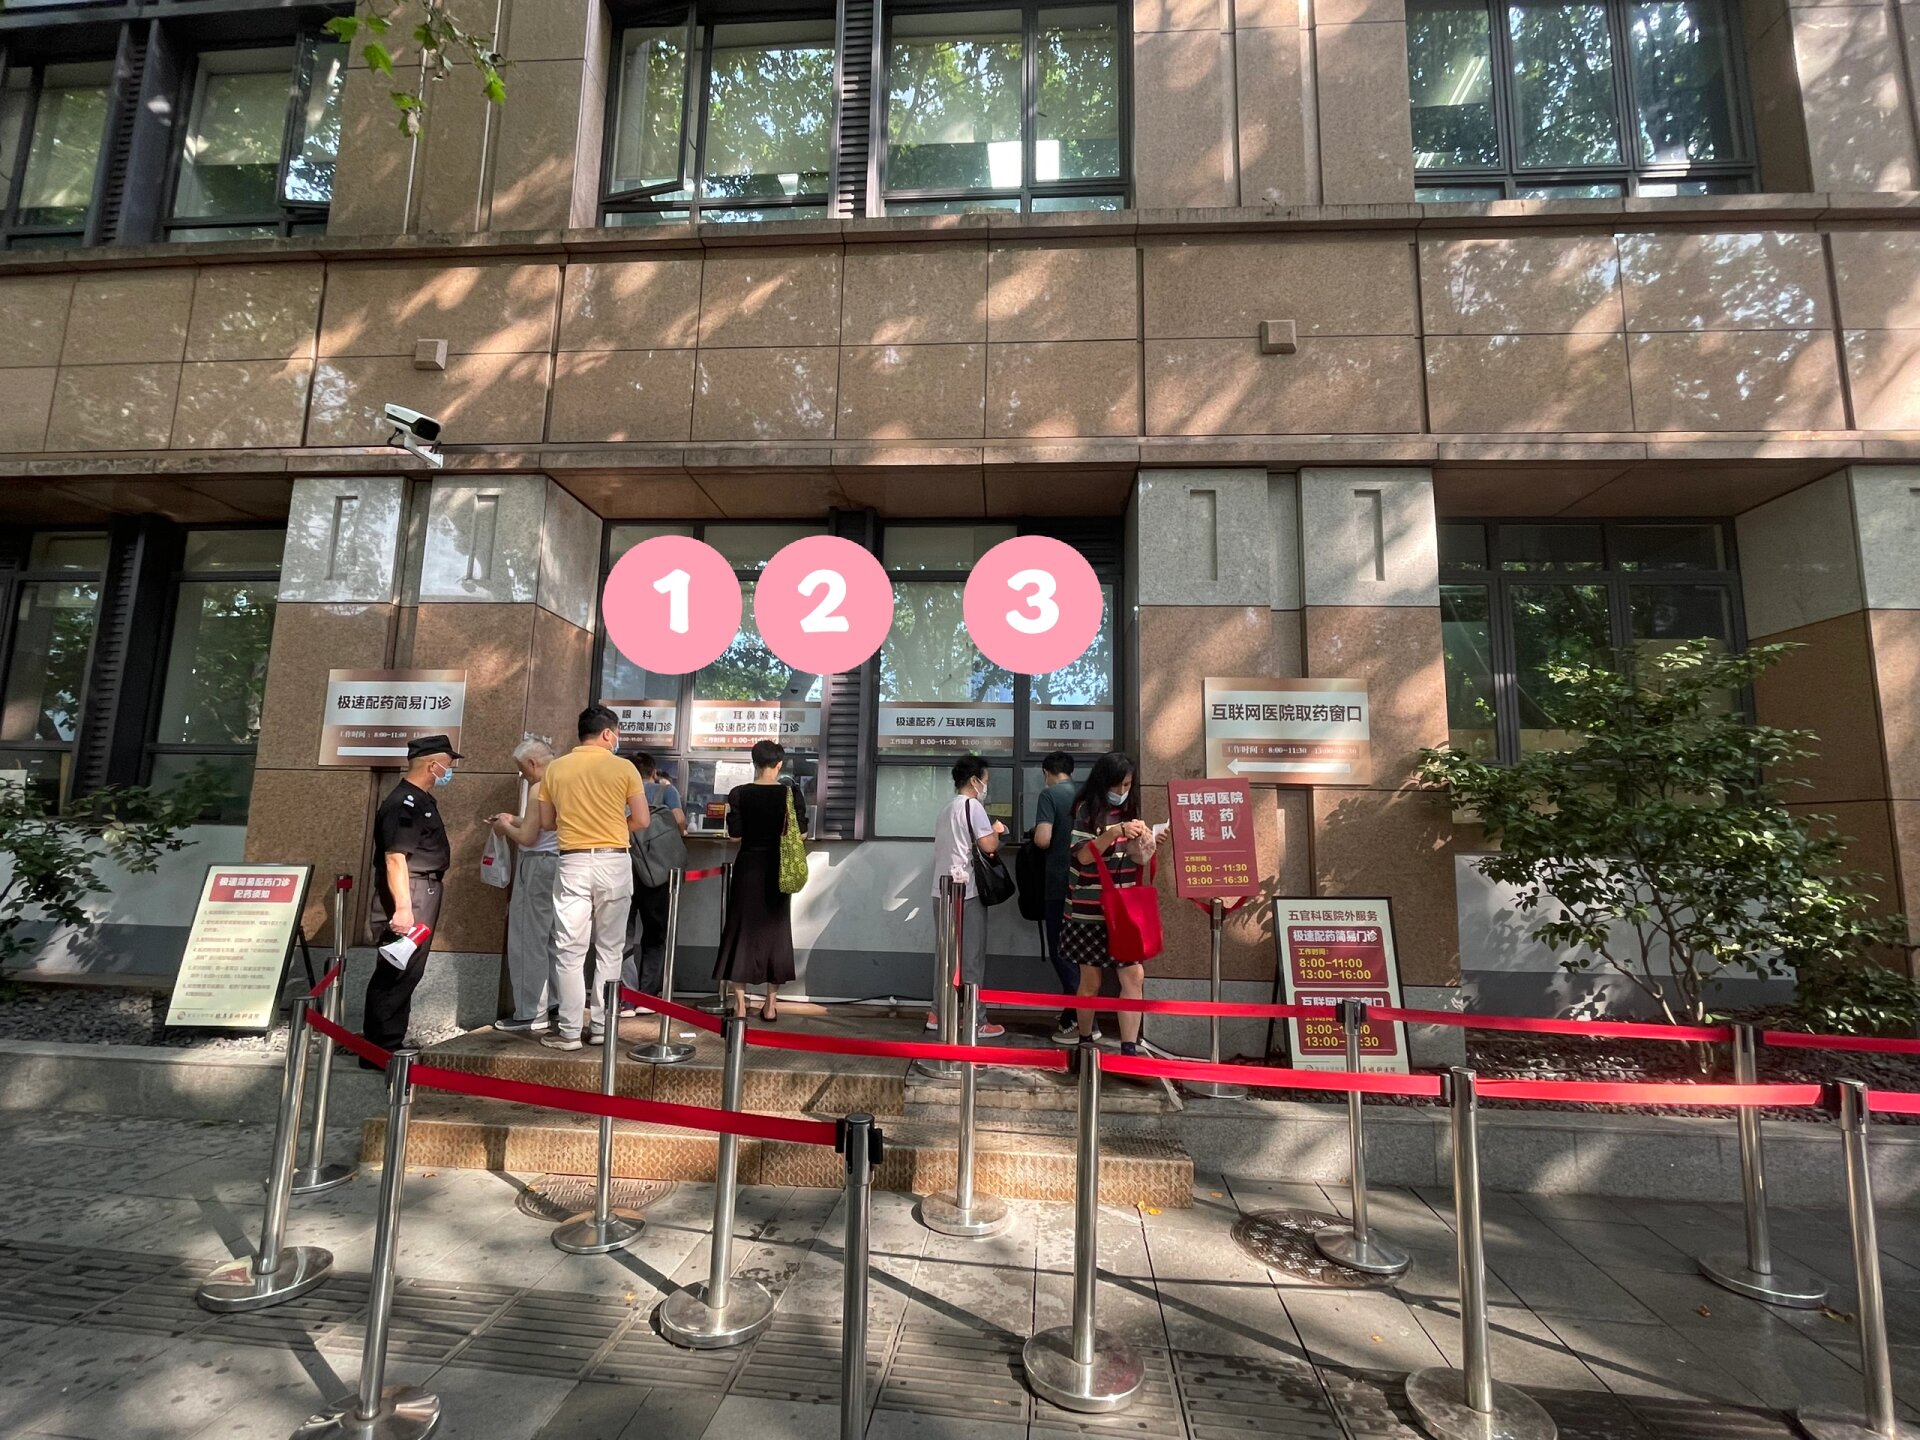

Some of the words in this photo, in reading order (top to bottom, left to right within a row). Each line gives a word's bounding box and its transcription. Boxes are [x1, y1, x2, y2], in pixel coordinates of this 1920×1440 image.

[337, 694, 452, 710] 极速配药简易门诊
[733, 710, 783, 720] 耳鼻喉科
[1211, 703, 1362, 722] 互联网医院取药窗口
[715, 723, 800, 733] 极速配药简易门诊
[1047, 719, 1095, 730] 取药窗口
[1176, 791, 1244, 806] 互联网医院
[1185, 864, 1213, 873] 08:00
[1222, 863, 1248, 872] 11:30
[1186, 876, 1213, 885] 13:00
[1223, 875, 1249, 884] 16:30
[1288, 910, 1378, 921] 五官科医院外服务
[1293, 929, 1378, 942] 极速配药简易门诊
[1305, 1036, 1379, 1047] 13:00-:30
